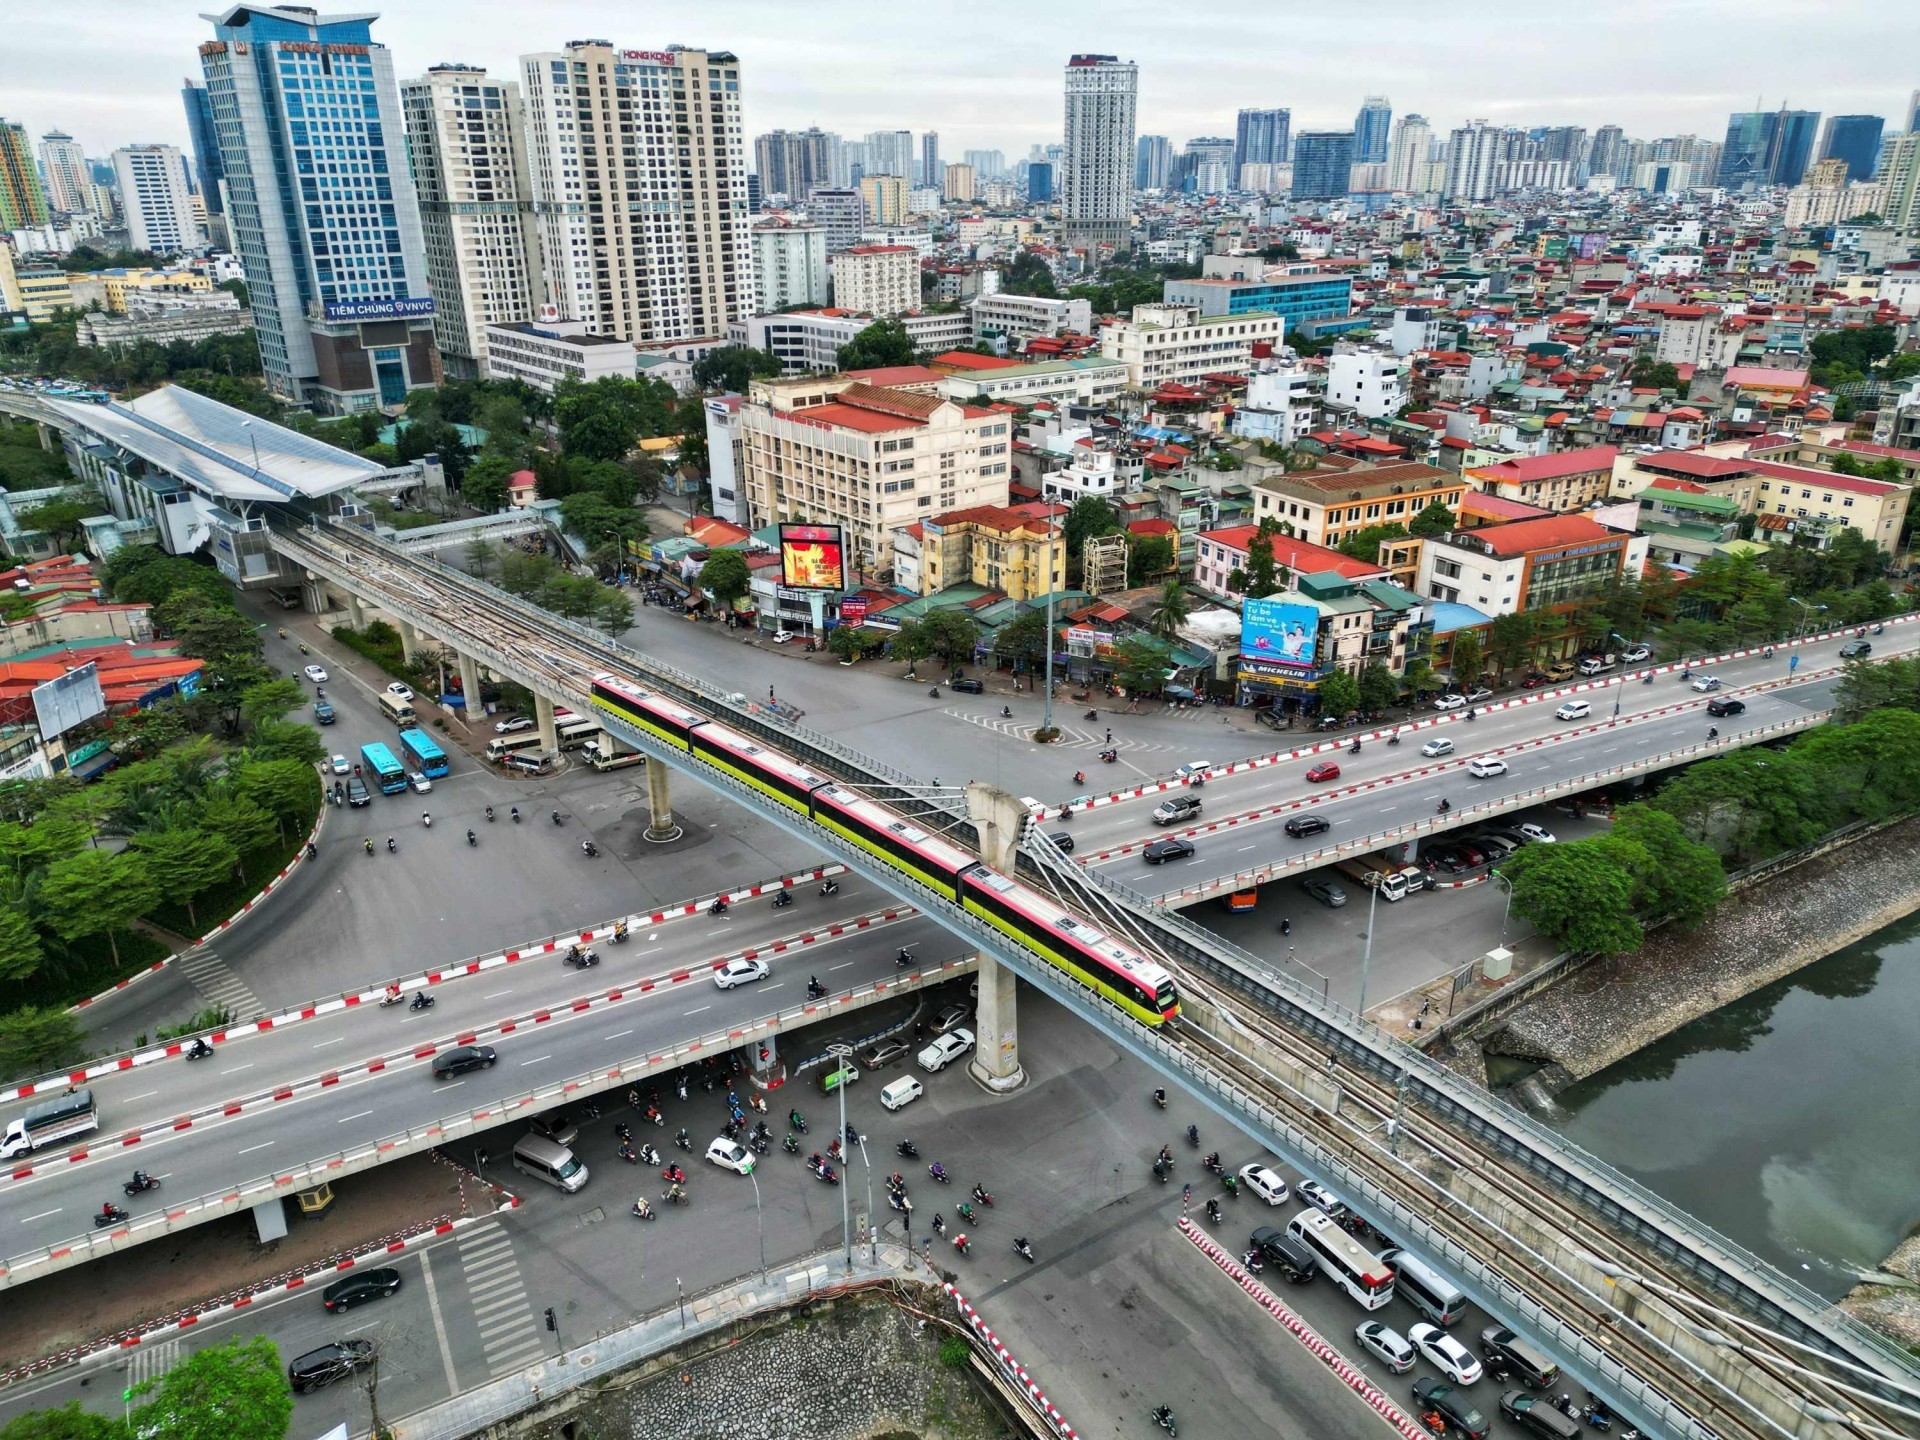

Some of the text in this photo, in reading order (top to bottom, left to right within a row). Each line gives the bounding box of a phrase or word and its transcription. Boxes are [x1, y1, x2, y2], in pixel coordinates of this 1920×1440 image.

[623, 51, 675, 61] HONG KONG
[404, 301, 432, 311] VNVC
[1258, 666, 1306, 677] MICHELIN
